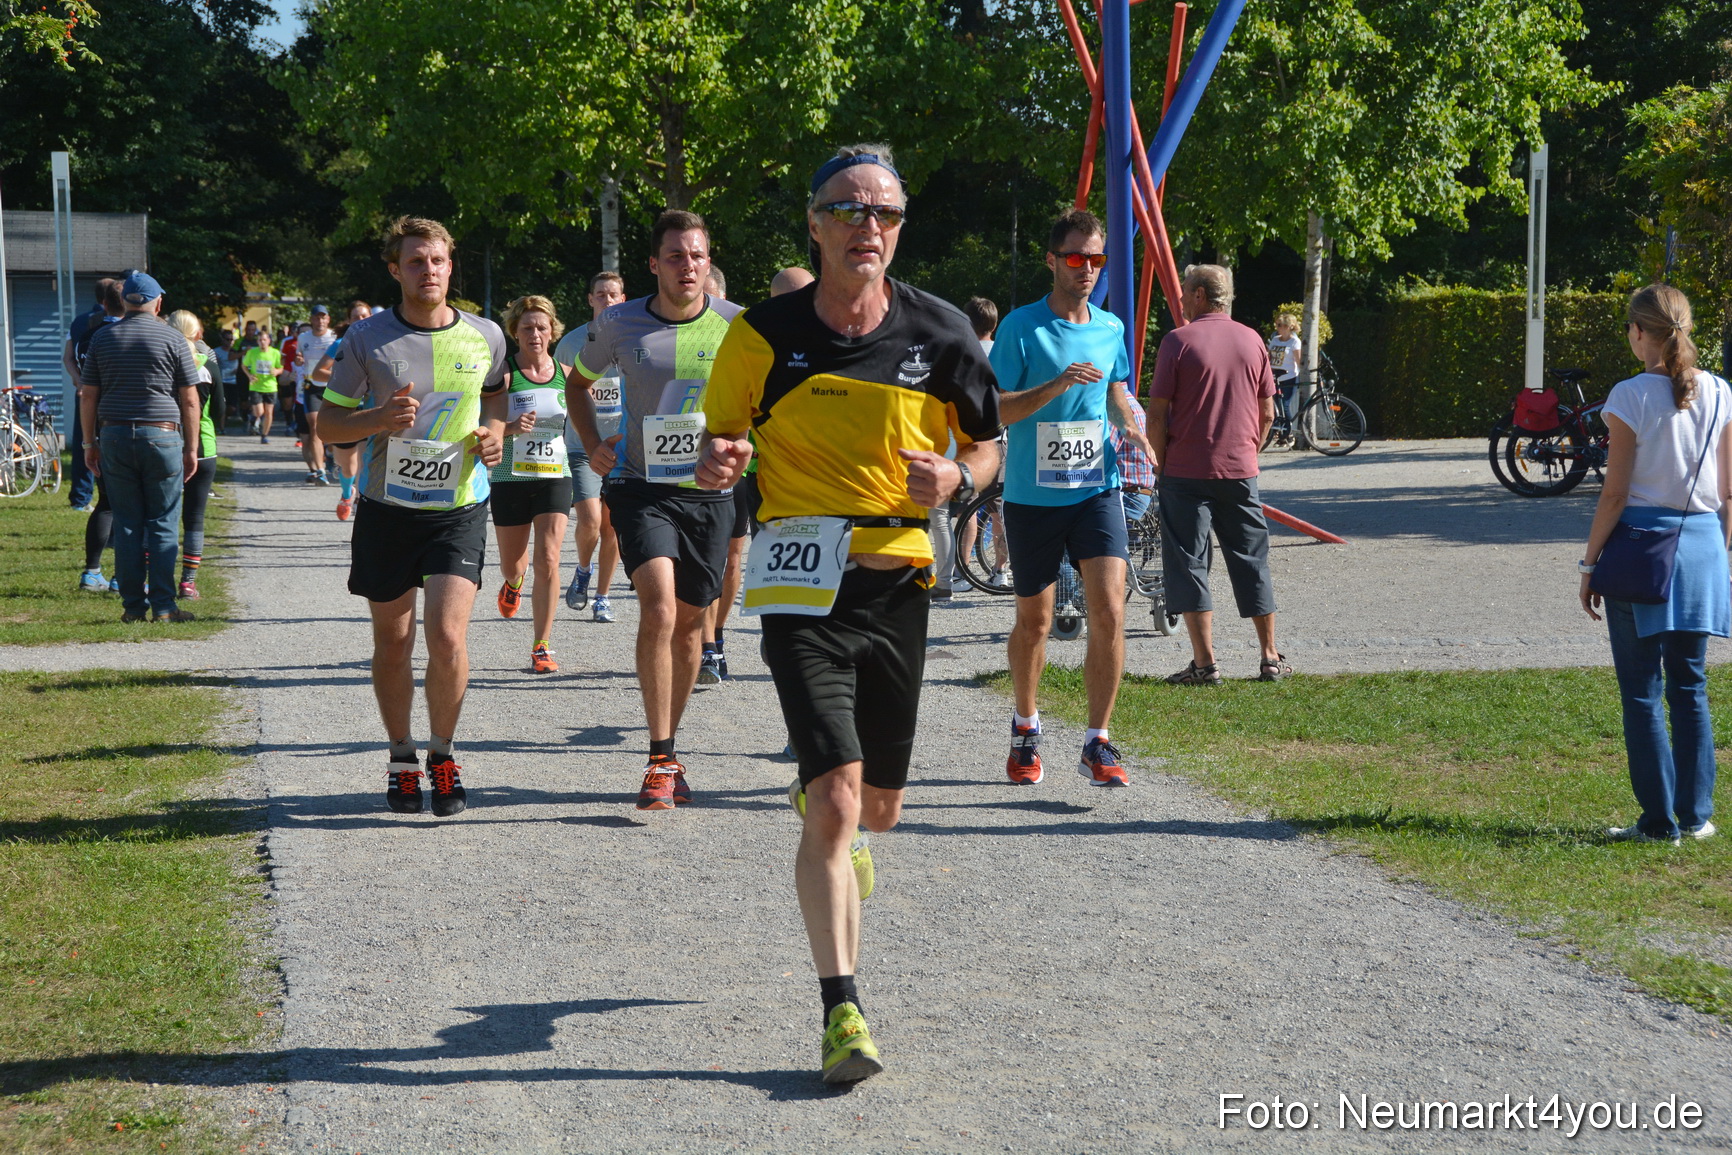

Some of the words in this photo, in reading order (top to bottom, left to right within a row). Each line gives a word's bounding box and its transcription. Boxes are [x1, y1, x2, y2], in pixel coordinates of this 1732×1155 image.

[907, 344, 925, 353] TSV
[787, 360, 809, 368] erima
[811, 387, 848, 397] Markus
[526, 440, 554, 457] 215
[1047, 439, 1094, 461] 2348
[398, 458, 452, 481] 2220
[525, 463, 553, 472] Christine
[665, 465, 697, 477] Domini
[1055, 471, 1088, 482] Dominik
[411, 491, 430, 502] Max
[767, 541, 822, 573] 320
[762, 575, 780, 583] PARTL
[780, 575, 811, 583] Neumarkt
